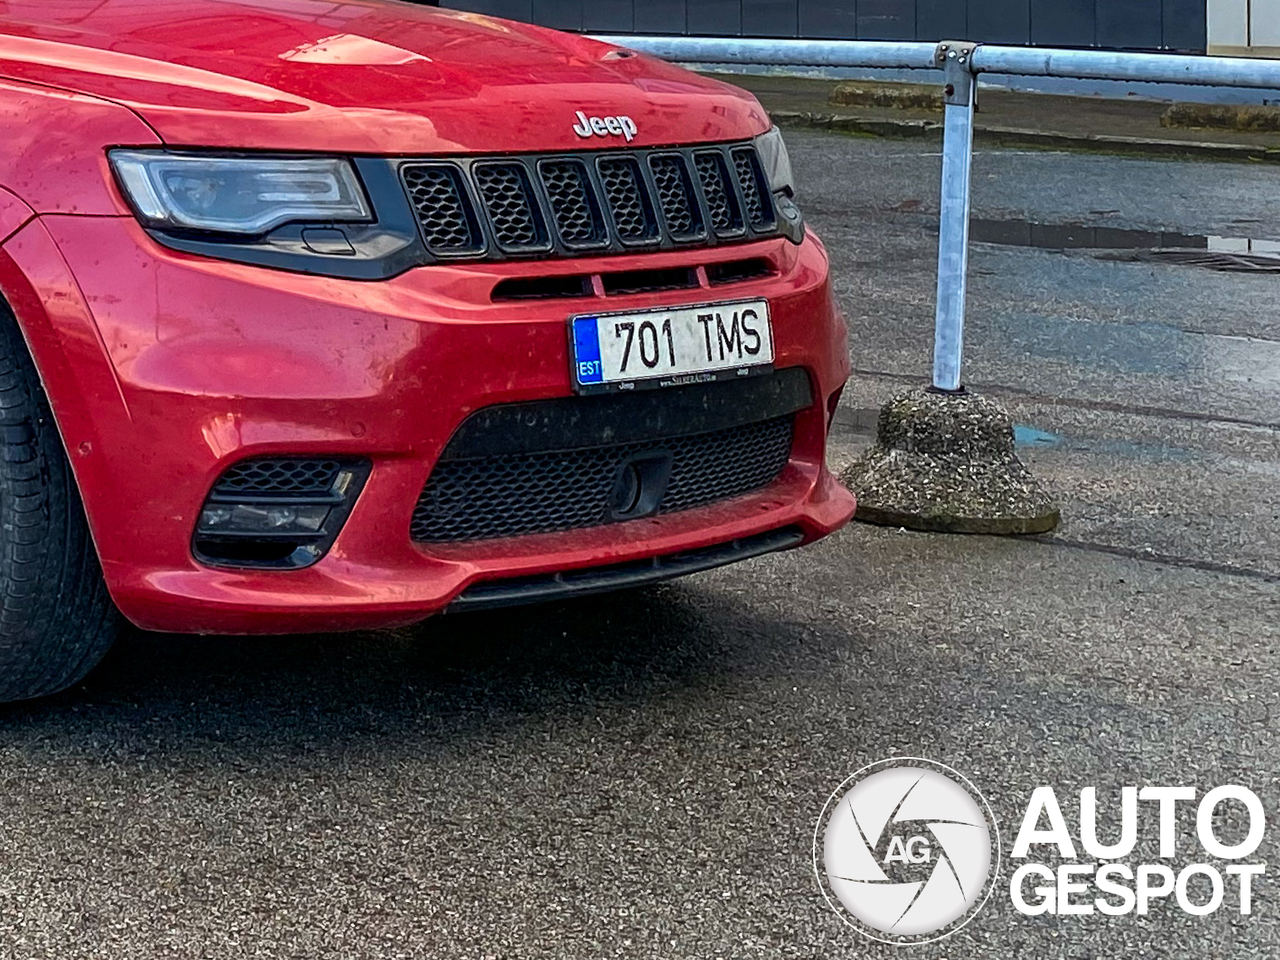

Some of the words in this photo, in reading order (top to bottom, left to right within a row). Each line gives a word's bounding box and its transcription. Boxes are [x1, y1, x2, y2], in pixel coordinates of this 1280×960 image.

[573, 111, 638, 142] Jeep
[614, 318, 676, 373] 701
[696, 308, 762, 363] TMS
[579, 359, 601, 376] EST
